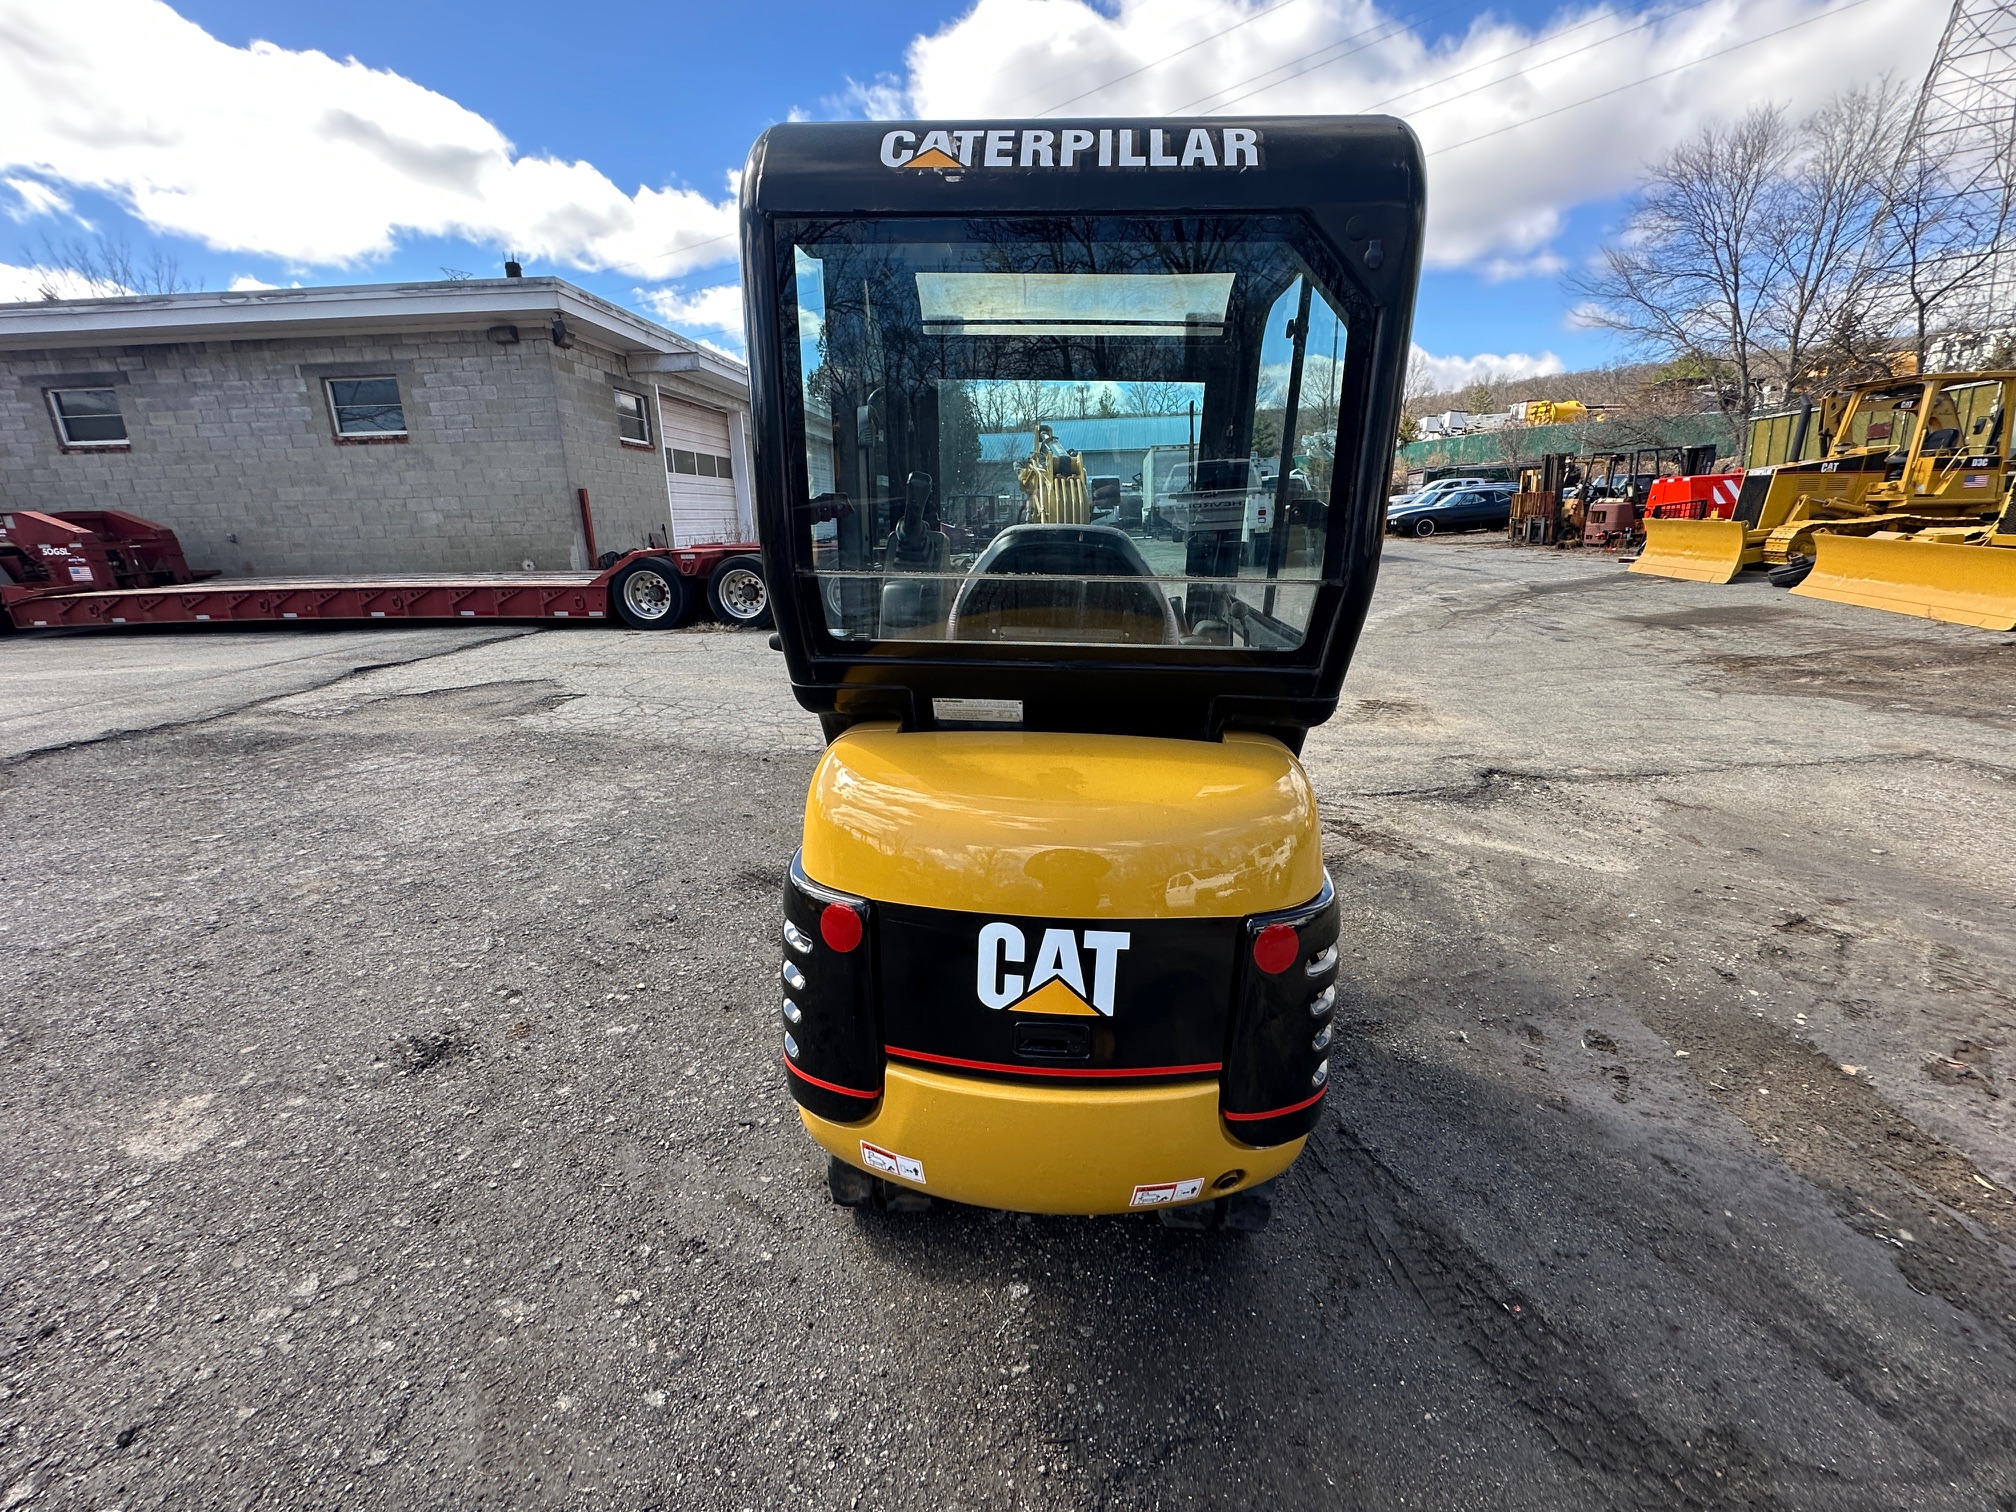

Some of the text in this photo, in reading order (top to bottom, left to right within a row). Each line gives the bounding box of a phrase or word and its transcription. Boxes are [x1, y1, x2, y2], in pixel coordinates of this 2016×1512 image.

[880, 128, 1259, 168] CATERPILLAR
[1900, 400, 1914, 409] CAT
[1820, 462, 1840, 473] CAT
[1971, 458, 1988, 467] D3C
[977, 922, 1130, 1017] CAT
